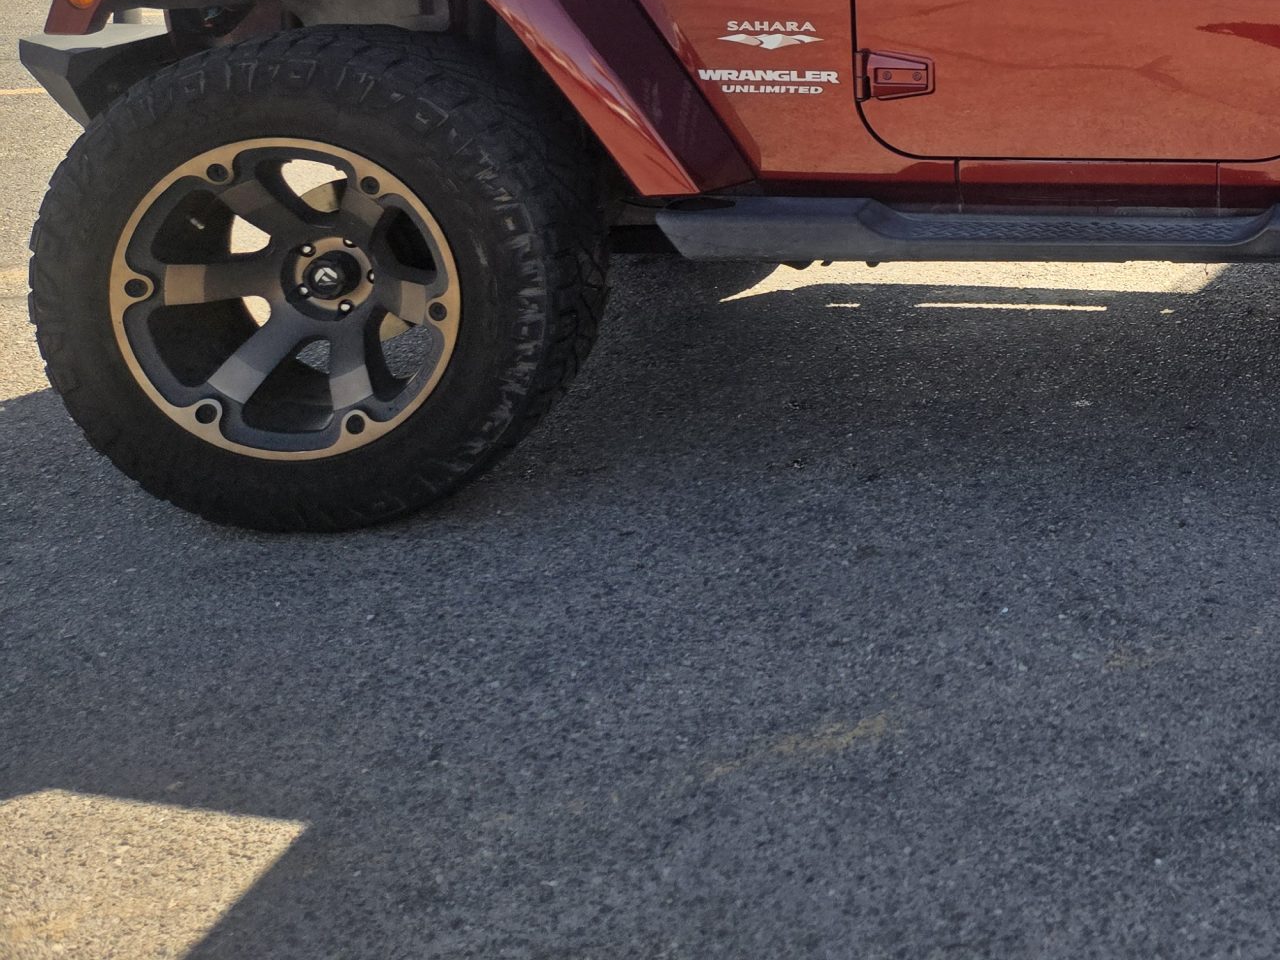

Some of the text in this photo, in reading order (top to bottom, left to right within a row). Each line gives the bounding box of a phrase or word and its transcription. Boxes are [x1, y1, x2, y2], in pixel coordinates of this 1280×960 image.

[727, 20, 817, 32] SAHARA
[698, 69, 840, 84] WRANGLER
[721, 85, 824, 95] UNLIMITED
